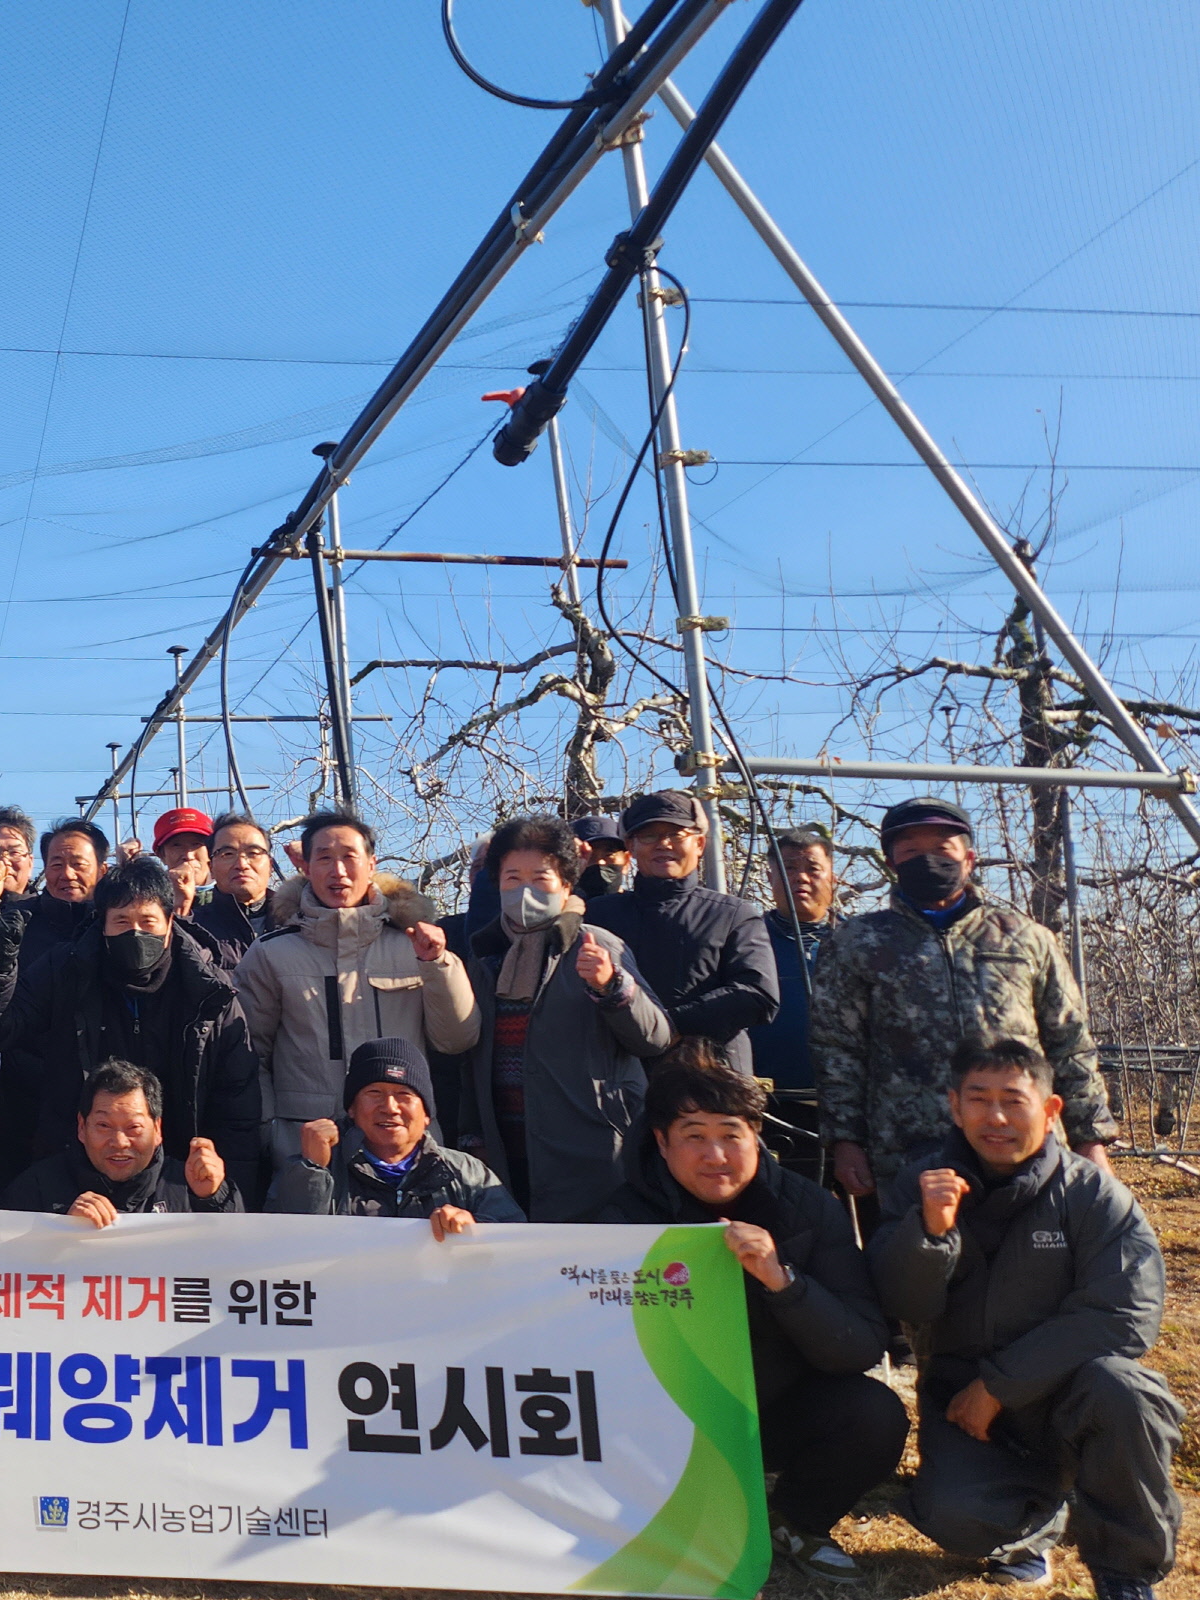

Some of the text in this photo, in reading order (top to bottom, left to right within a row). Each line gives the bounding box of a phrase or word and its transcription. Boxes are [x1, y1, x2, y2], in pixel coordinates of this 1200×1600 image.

[560, 1264, 608, 1286] 역사를
[633, 1268, 661, 1286] 도시
[81, 1274, 213, 1324] 제거를
[227, 1279, 317, 1327] 위한
[589, 1287, 634, 1306] 미래를
[660, 1287, 695, 1310] 경주
[337, 1361, 603, 1463] 연시회
[75, 1499, 329, 1539] 경주시농업기술센터
